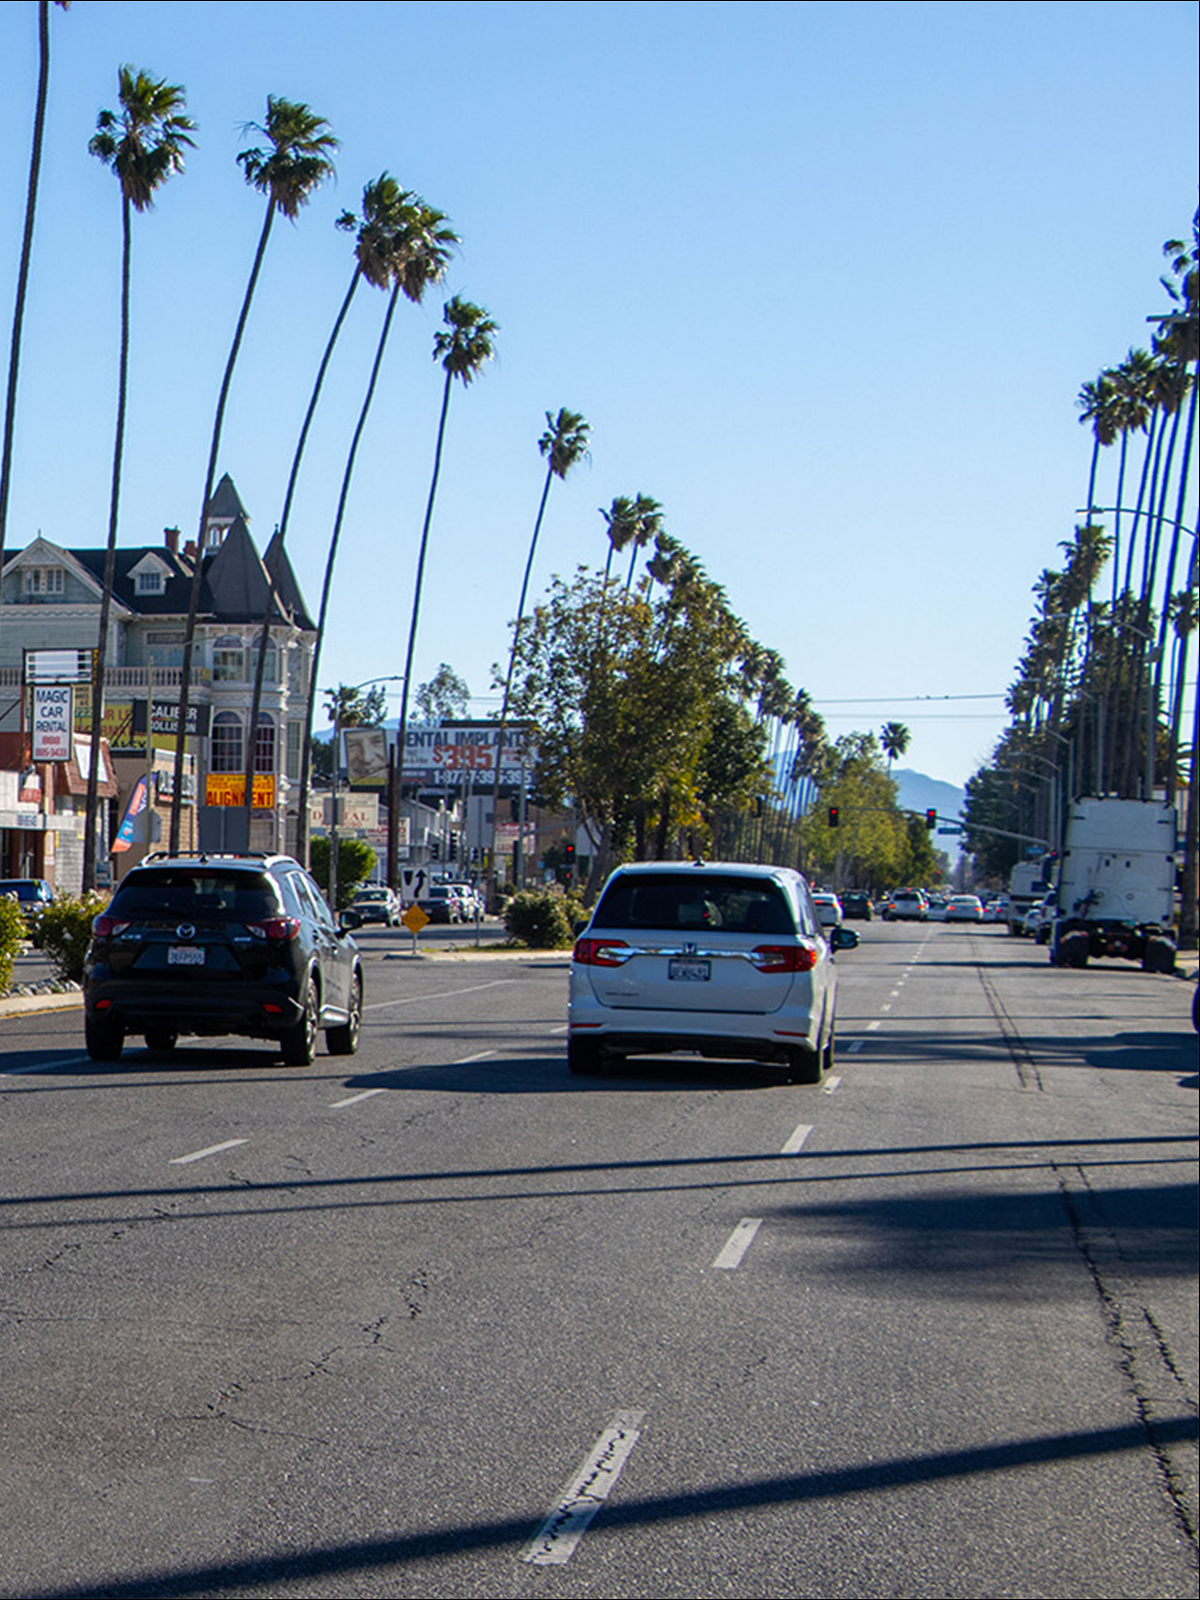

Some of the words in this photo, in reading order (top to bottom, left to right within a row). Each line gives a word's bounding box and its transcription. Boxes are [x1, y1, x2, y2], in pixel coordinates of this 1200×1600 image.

[35, 690, 68, 703] MAGIC
[40, 706, 63, 718] CAR
[36, 721, 67, 733] RENTAL
[150, 719, 197, 732] OLLISON
[401, 731, 448, 747] ENTAL
[432, 744, 493, 770] $395
[312, 810, 369, 821] DTAL
